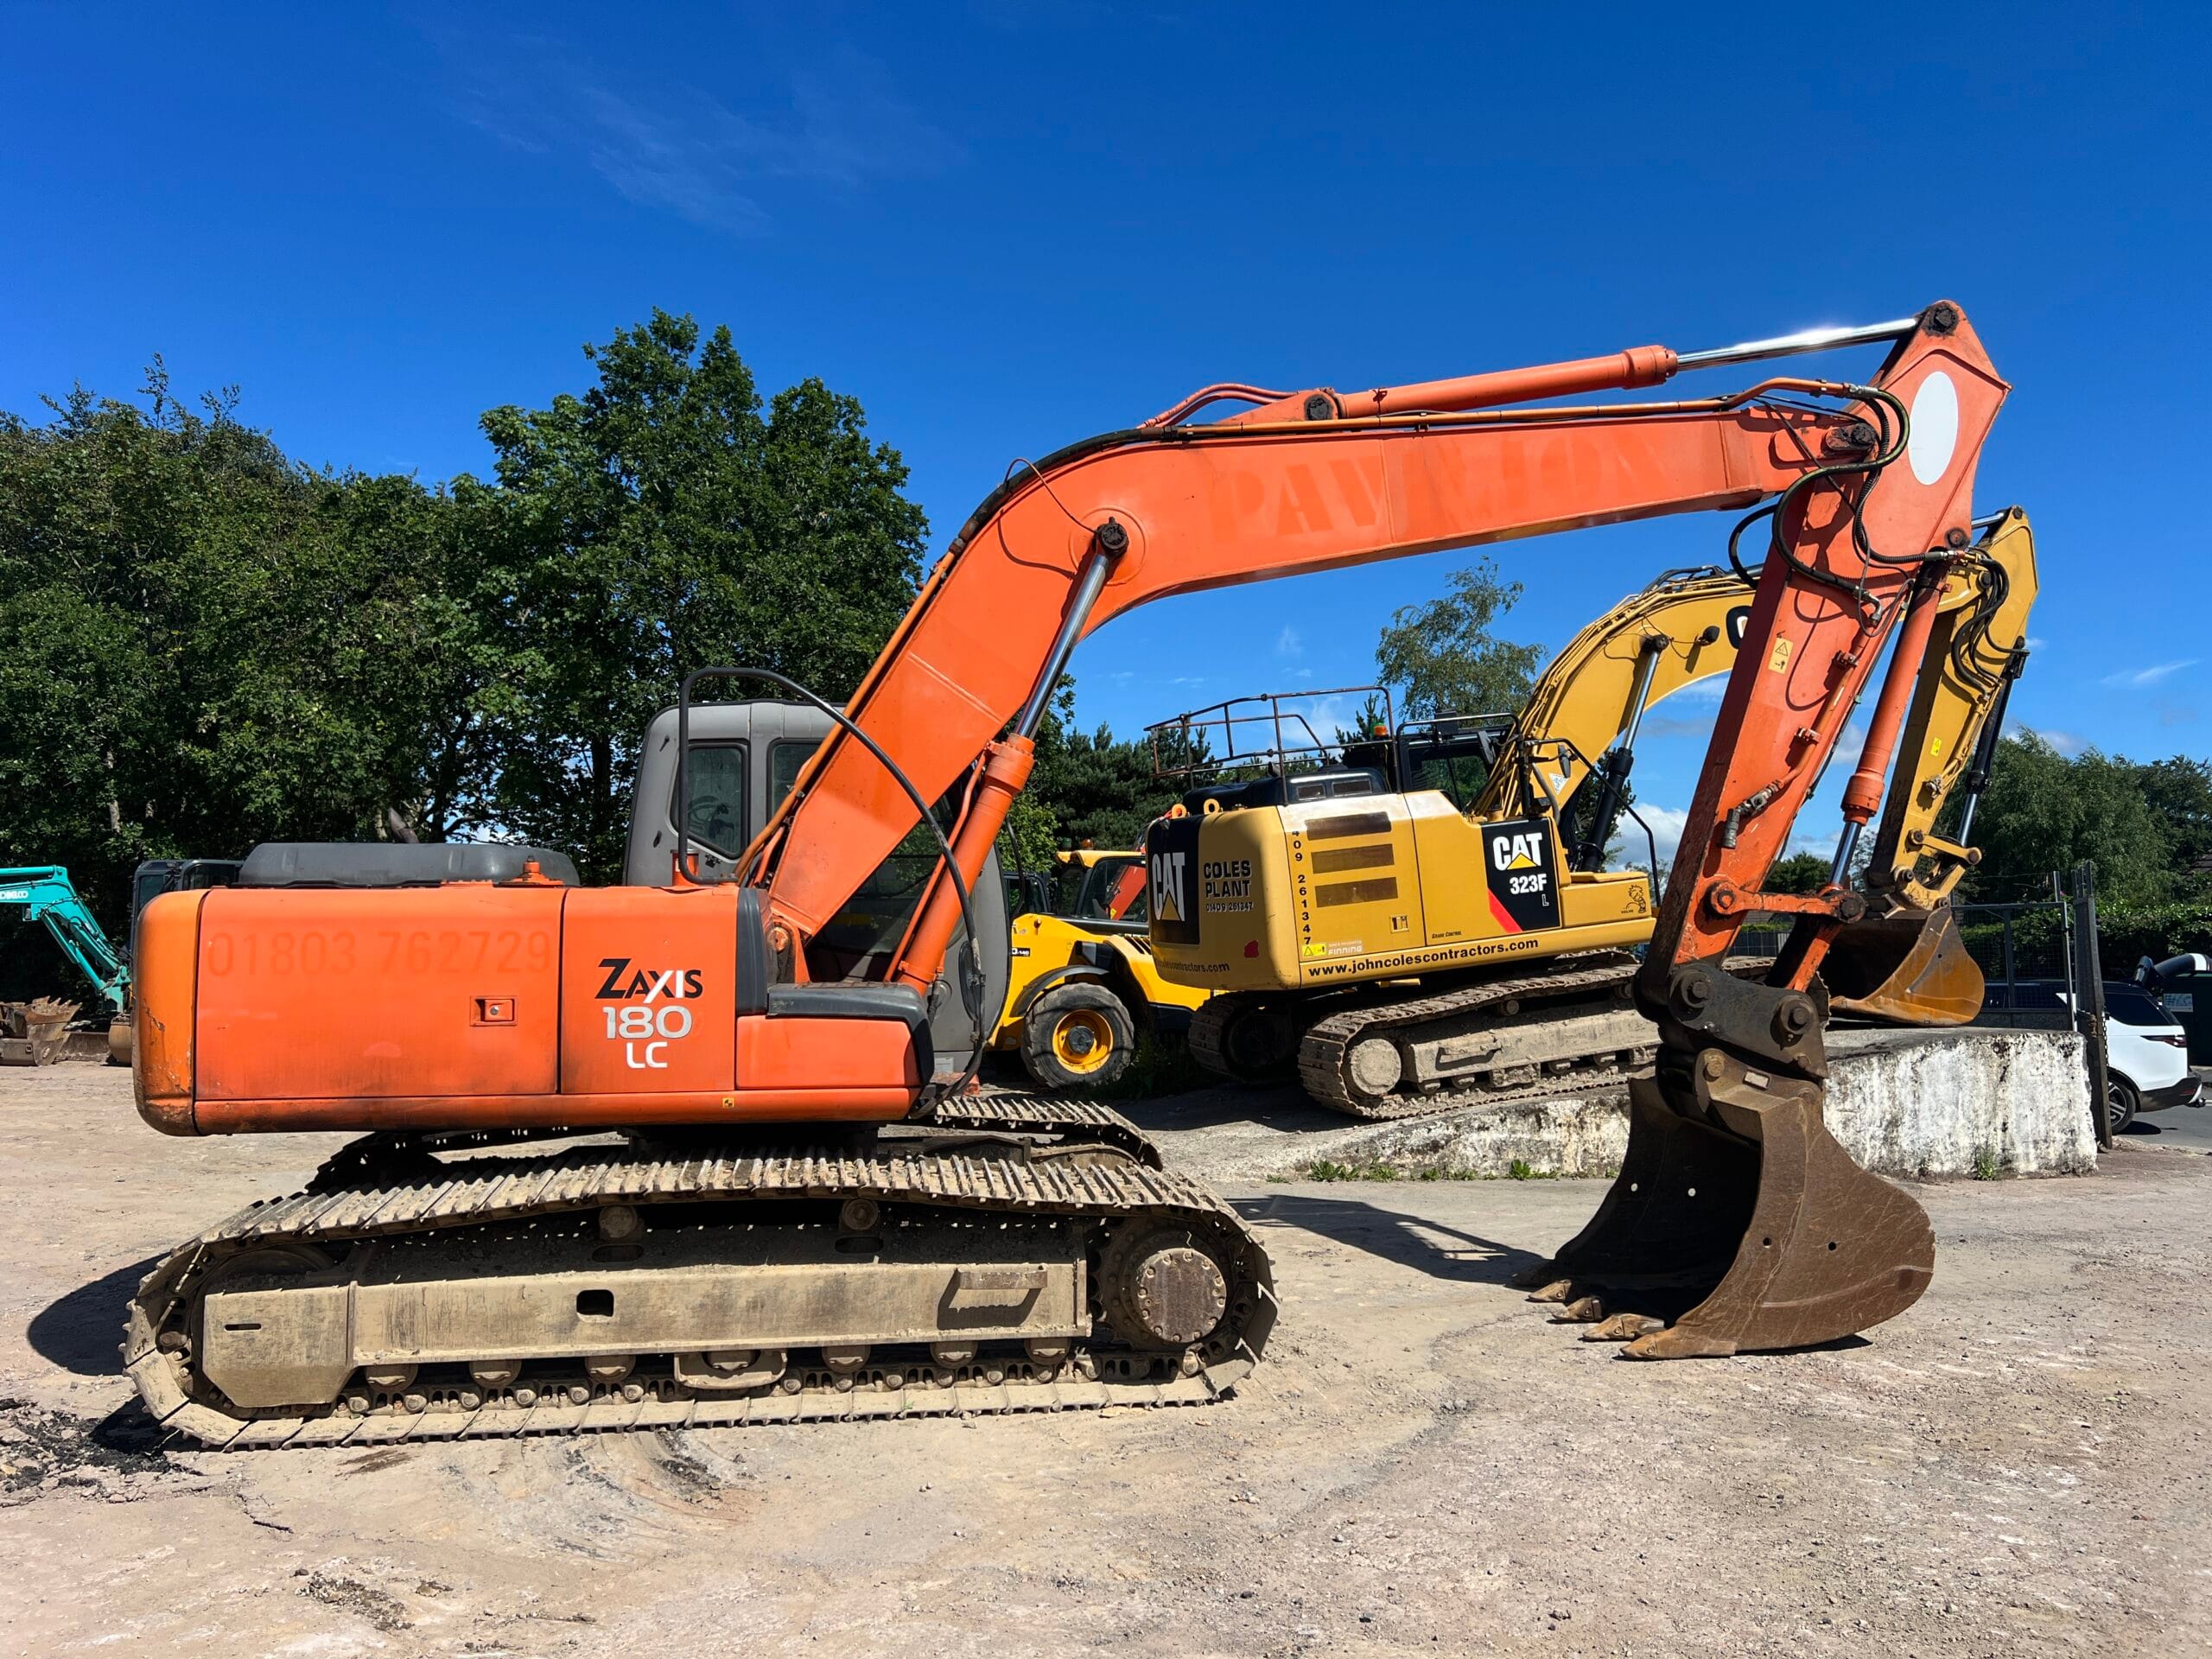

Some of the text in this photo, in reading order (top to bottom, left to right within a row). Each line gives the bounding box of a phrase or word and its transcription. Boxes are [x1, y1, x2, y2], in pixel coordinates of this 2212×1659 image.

[1492, 832, 1543, 872] CAT
[1152, 852, 1185, 922] CAT
[1204, 860, 1252, 880] COLES
[1510, 874, 1548, 895] 323F
[1205, 880, 1251, 899] PLANT
[1541, 894, 1549, 906] L
[207, 930, 551, 977] 01803 762729
[1308, 938, 1540, 976] www.johncolescontractors.com
[594, 958, 703, 1004] ZAXIS
[602, 1005, 692, 1039] 180
[626, 1041, 668, 1069] LC
